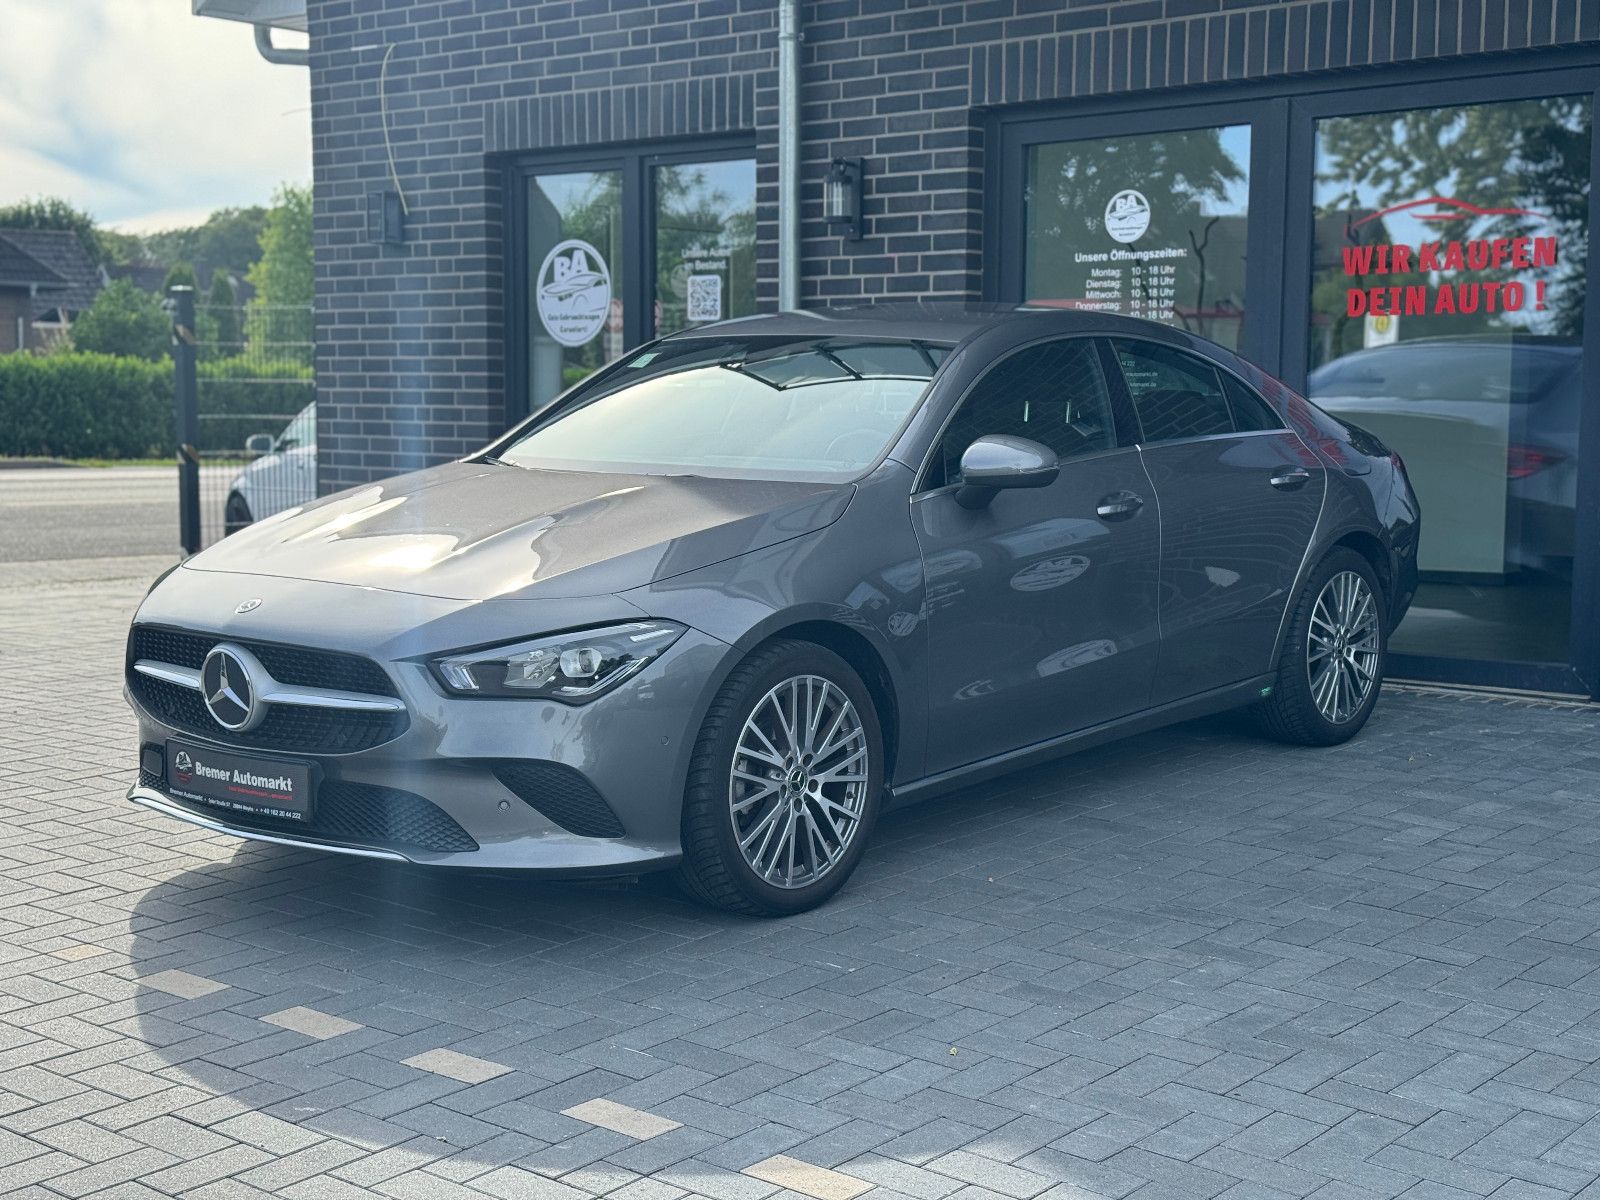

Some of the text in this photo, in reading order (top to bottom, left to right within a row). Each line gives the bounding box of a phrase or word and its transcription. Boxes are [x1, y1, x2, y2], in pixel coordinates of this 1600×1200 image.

[1074, 248, 1187, 263] Unsere Öffnungszeiten:
[1342, 236, 1558, 276] WIR KAUFEN
[1091, 268, 1122, 278] Montag:
[1131, 266, 1141, 275] 10
[1148, 265, 1159, 275] 18
[1160, 265, 1176, 274] Uhr
[1085, 279, 1122, 289] Dienstag:
[1131, 278, 1141, 286] 10
[1148, 277, 1159, 286] 18
[1160, 276, 1175, 286] Uhr
[1085, 290, 1122, 299] Mittwoch:
[1130, 289, 1141, 298] 10
[1148, 288, 1159, 297] 18
[1160, 288, 1175, 297] Uhr
[1347, 280, 1546, 318] DEIN AUTO !
[1130, 300, 1141, 308] 10
[1147, 299, 1158, 308] 18
[1159, 299, 1175, 308] Uhr
[1147, 310, 1158, 319] 18
[1159, 310, 1175, 319] Uhr
[195, 761, 231, 782] Bremer
[232, 769, 293, 792] Automarkt
